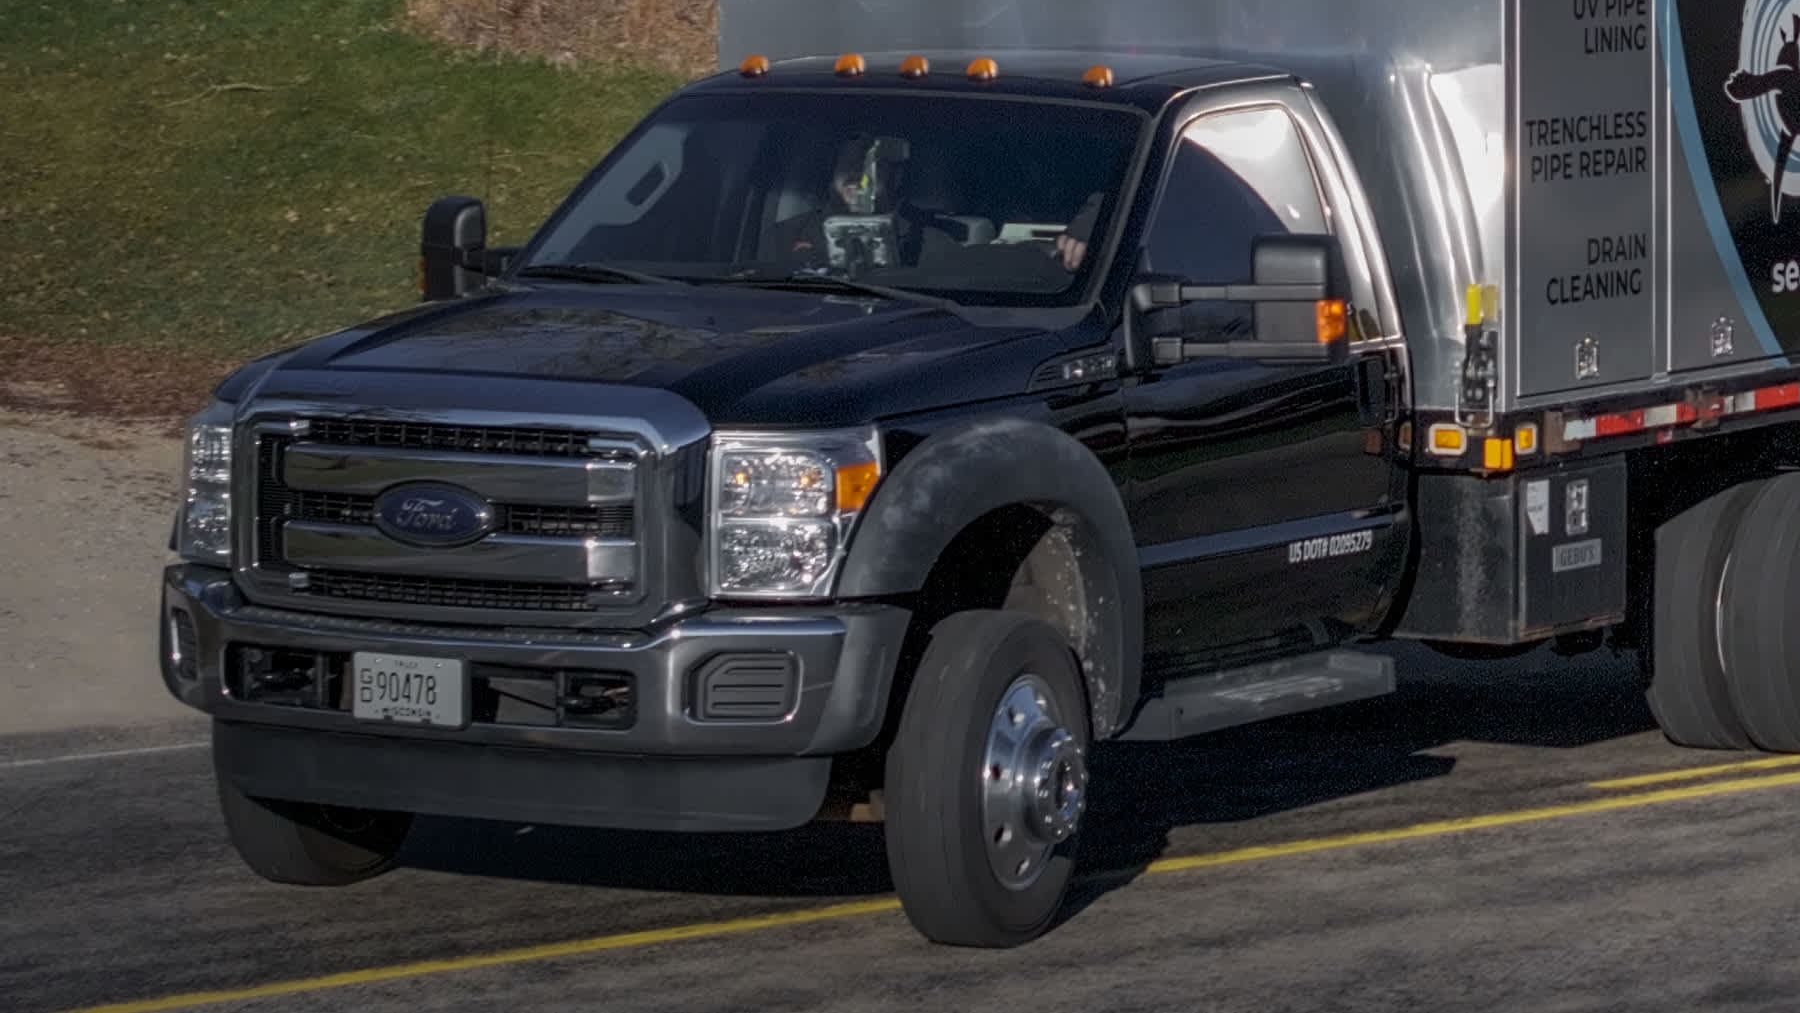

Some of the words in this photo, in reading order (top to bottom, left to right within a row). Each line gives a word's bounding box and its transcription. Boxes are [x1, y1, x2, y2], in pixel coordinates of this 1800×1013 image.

[1583, 23, 1647, 55] LINING
[1525, 110, 1648, 148] TRENCHLESS
[1531, 152, 1573, 183] PIPE
[1579, 145, 1647, 179] REPAIR
[1587, 233, 1647, 266] DRAIN
[1546, 268, 1642, 306] CLEANING
[395, 497, 463, 530] Ford
[1288, 541, 1303, 564] US
[1302, 537, 1329, 561] DOT#
[375, 671, 437, 706] 90478
